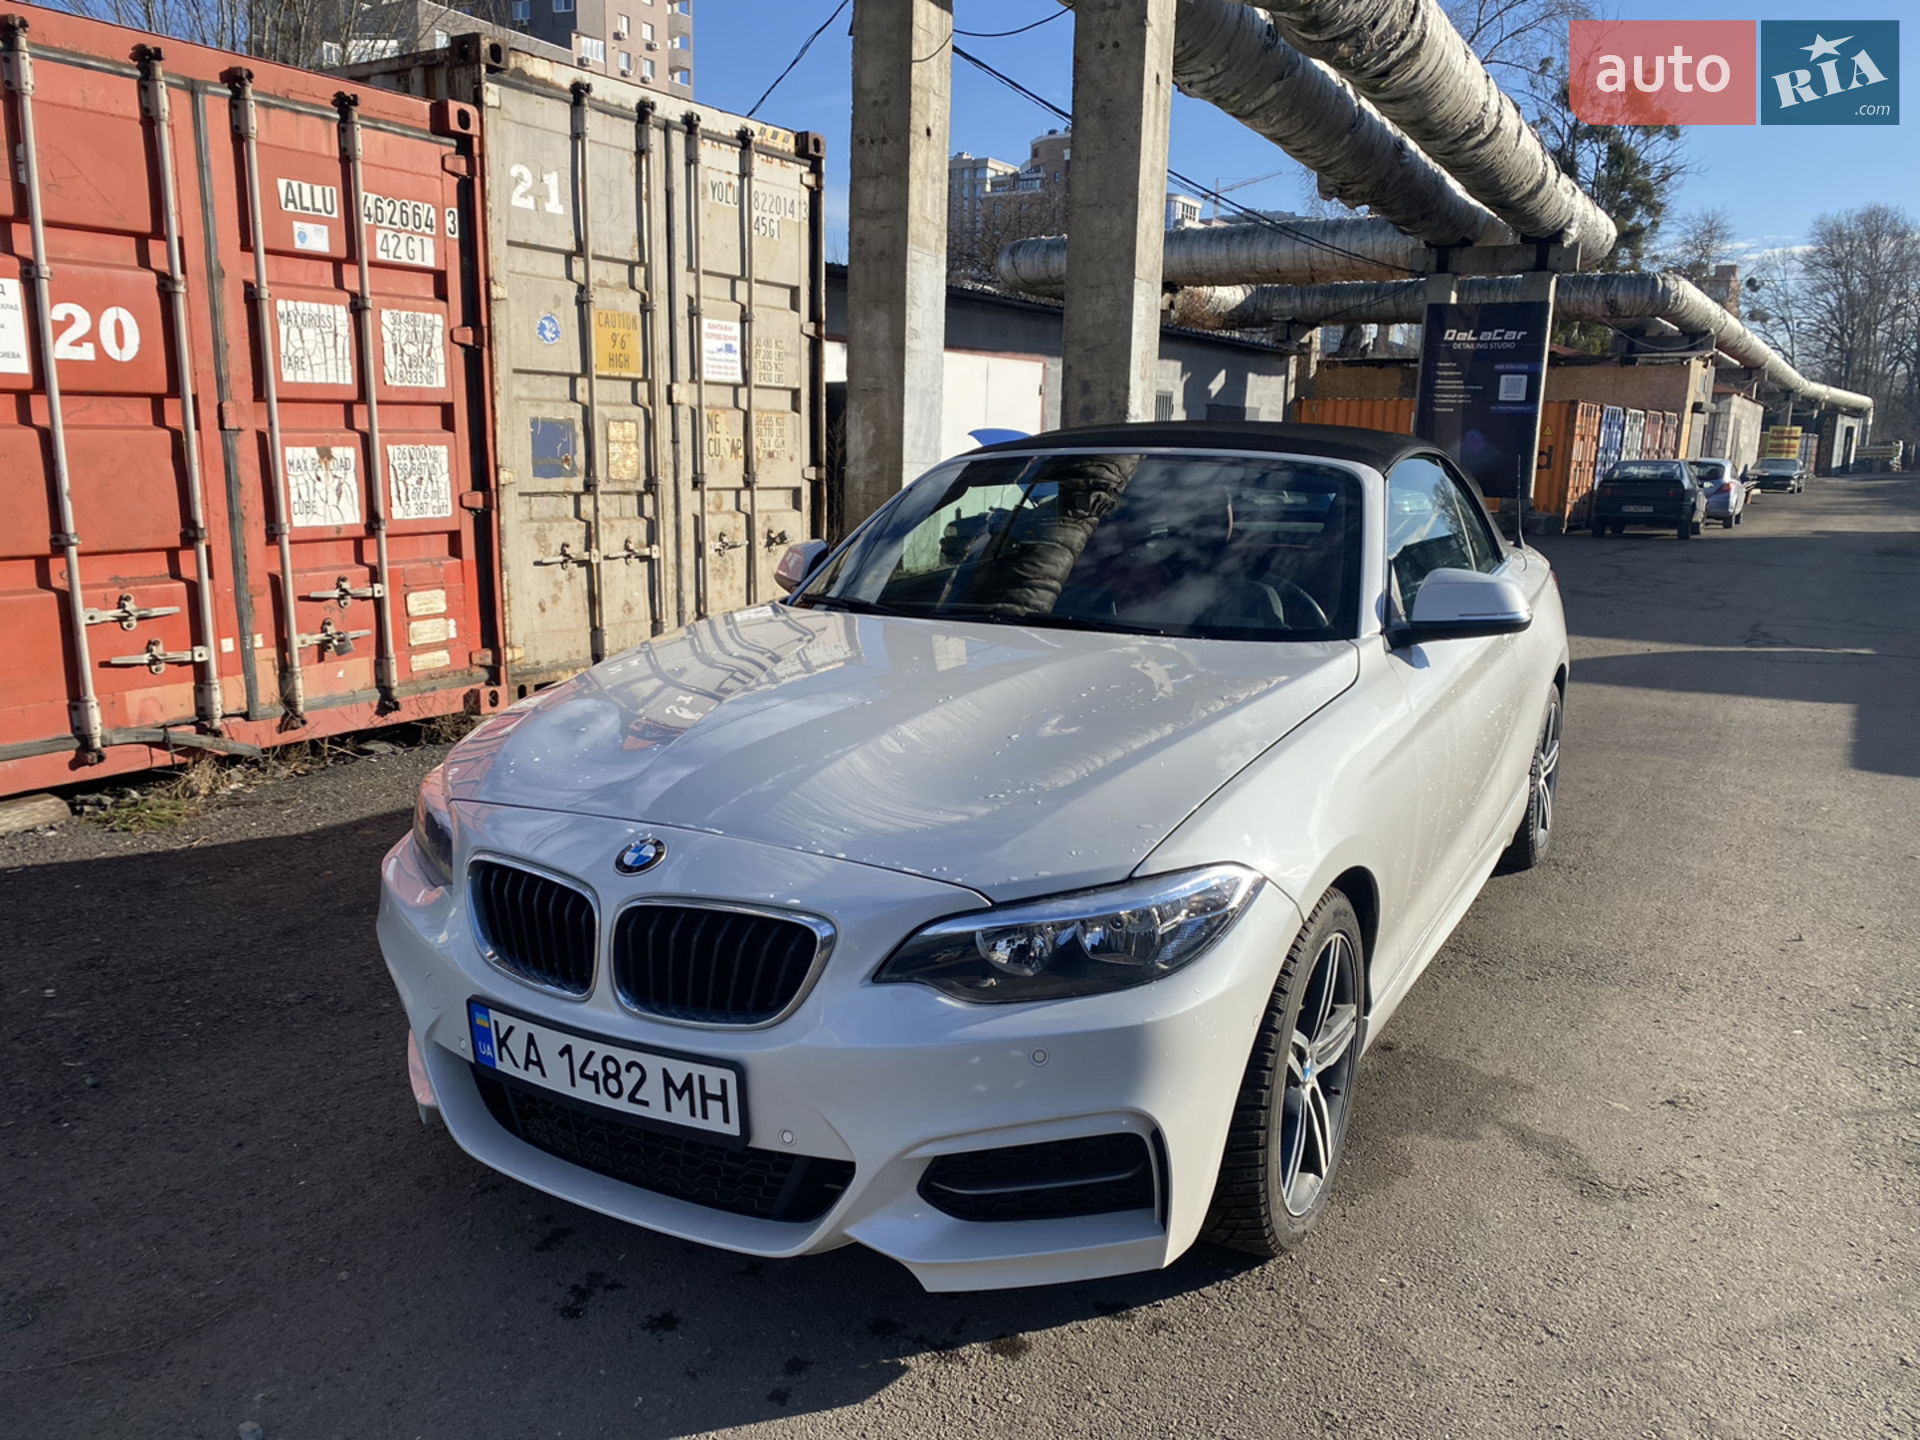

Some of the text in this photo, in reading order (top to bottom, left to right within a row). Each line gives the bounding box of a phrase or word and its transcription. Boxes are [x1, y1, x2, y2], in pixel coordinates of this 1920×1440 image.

[510, 163, 565, 215] 21
[284, 181, 457, 236] ALLU 462664 3
[753, 190, 795, 219] 822014
[753, 215, 780, 239] 45G1
[379, 234, 426, 262] 42G1
[278, 310, 333, 329] MAX GROSS
[597, 311, 638, 331] CAUTION
[51, 302, 140, 362] 20
[1452, 341, 1516, 350] DETAILING STUDIO
[282, 355, 306, 371] TARE
[608, 352, 630, 369] HIGH
[775, 350, 785, 361] LBS
[775, 373, 785, 384] LBS
[287, 458, 308, 473] MAX
[293, 500, 317, 516] CUBE
[414, 502, 429, 516] 387
[478, 1041, 495, 1058] UA
[493, 1019, 731, 1125] KA 1482 MH
